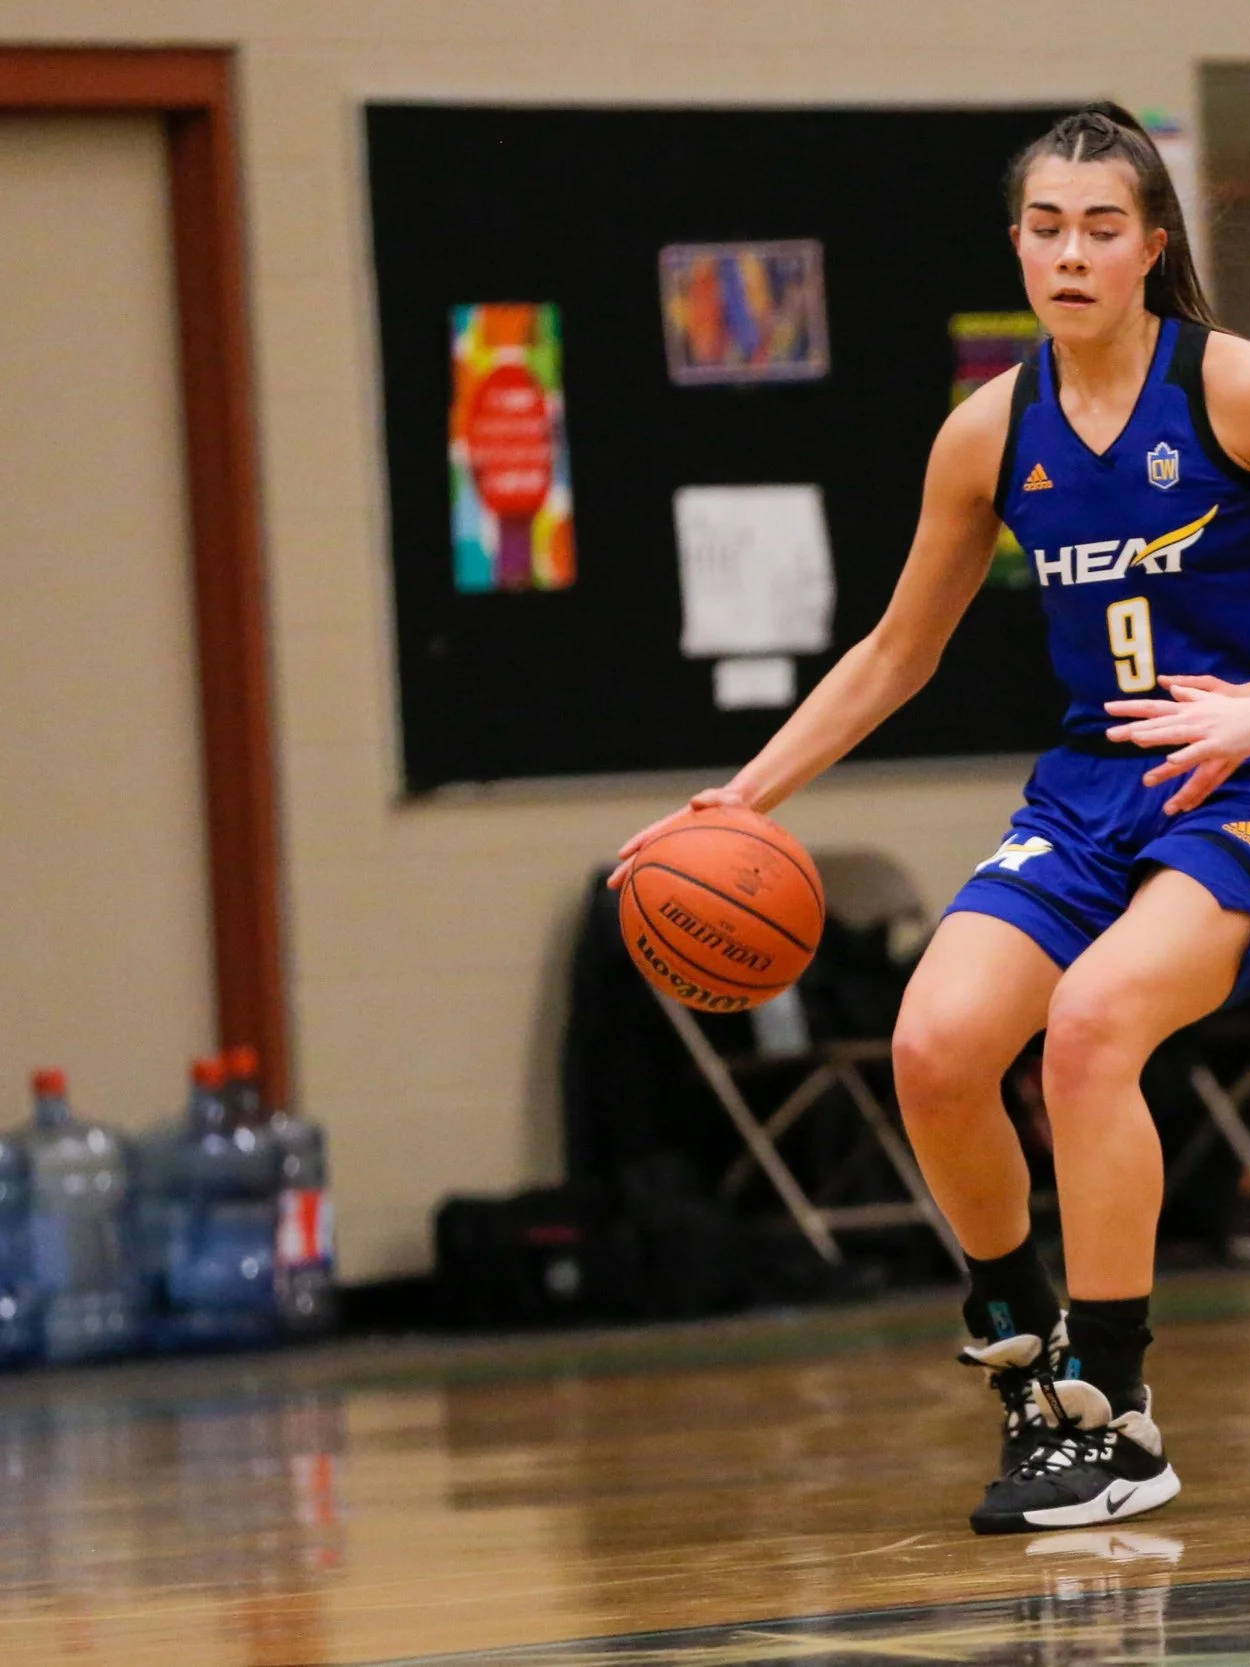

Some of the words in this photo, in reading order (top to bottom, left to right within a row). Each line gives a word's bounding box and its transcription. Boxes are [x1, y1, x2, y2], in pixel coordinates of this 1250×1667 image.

[1151, 458, 1177, 481] CW
[1034, 504, 1219, 586] HEAT
[1106, 596, 1157, 693] 9
[658, 901, 774, 972] EVOLUTION
